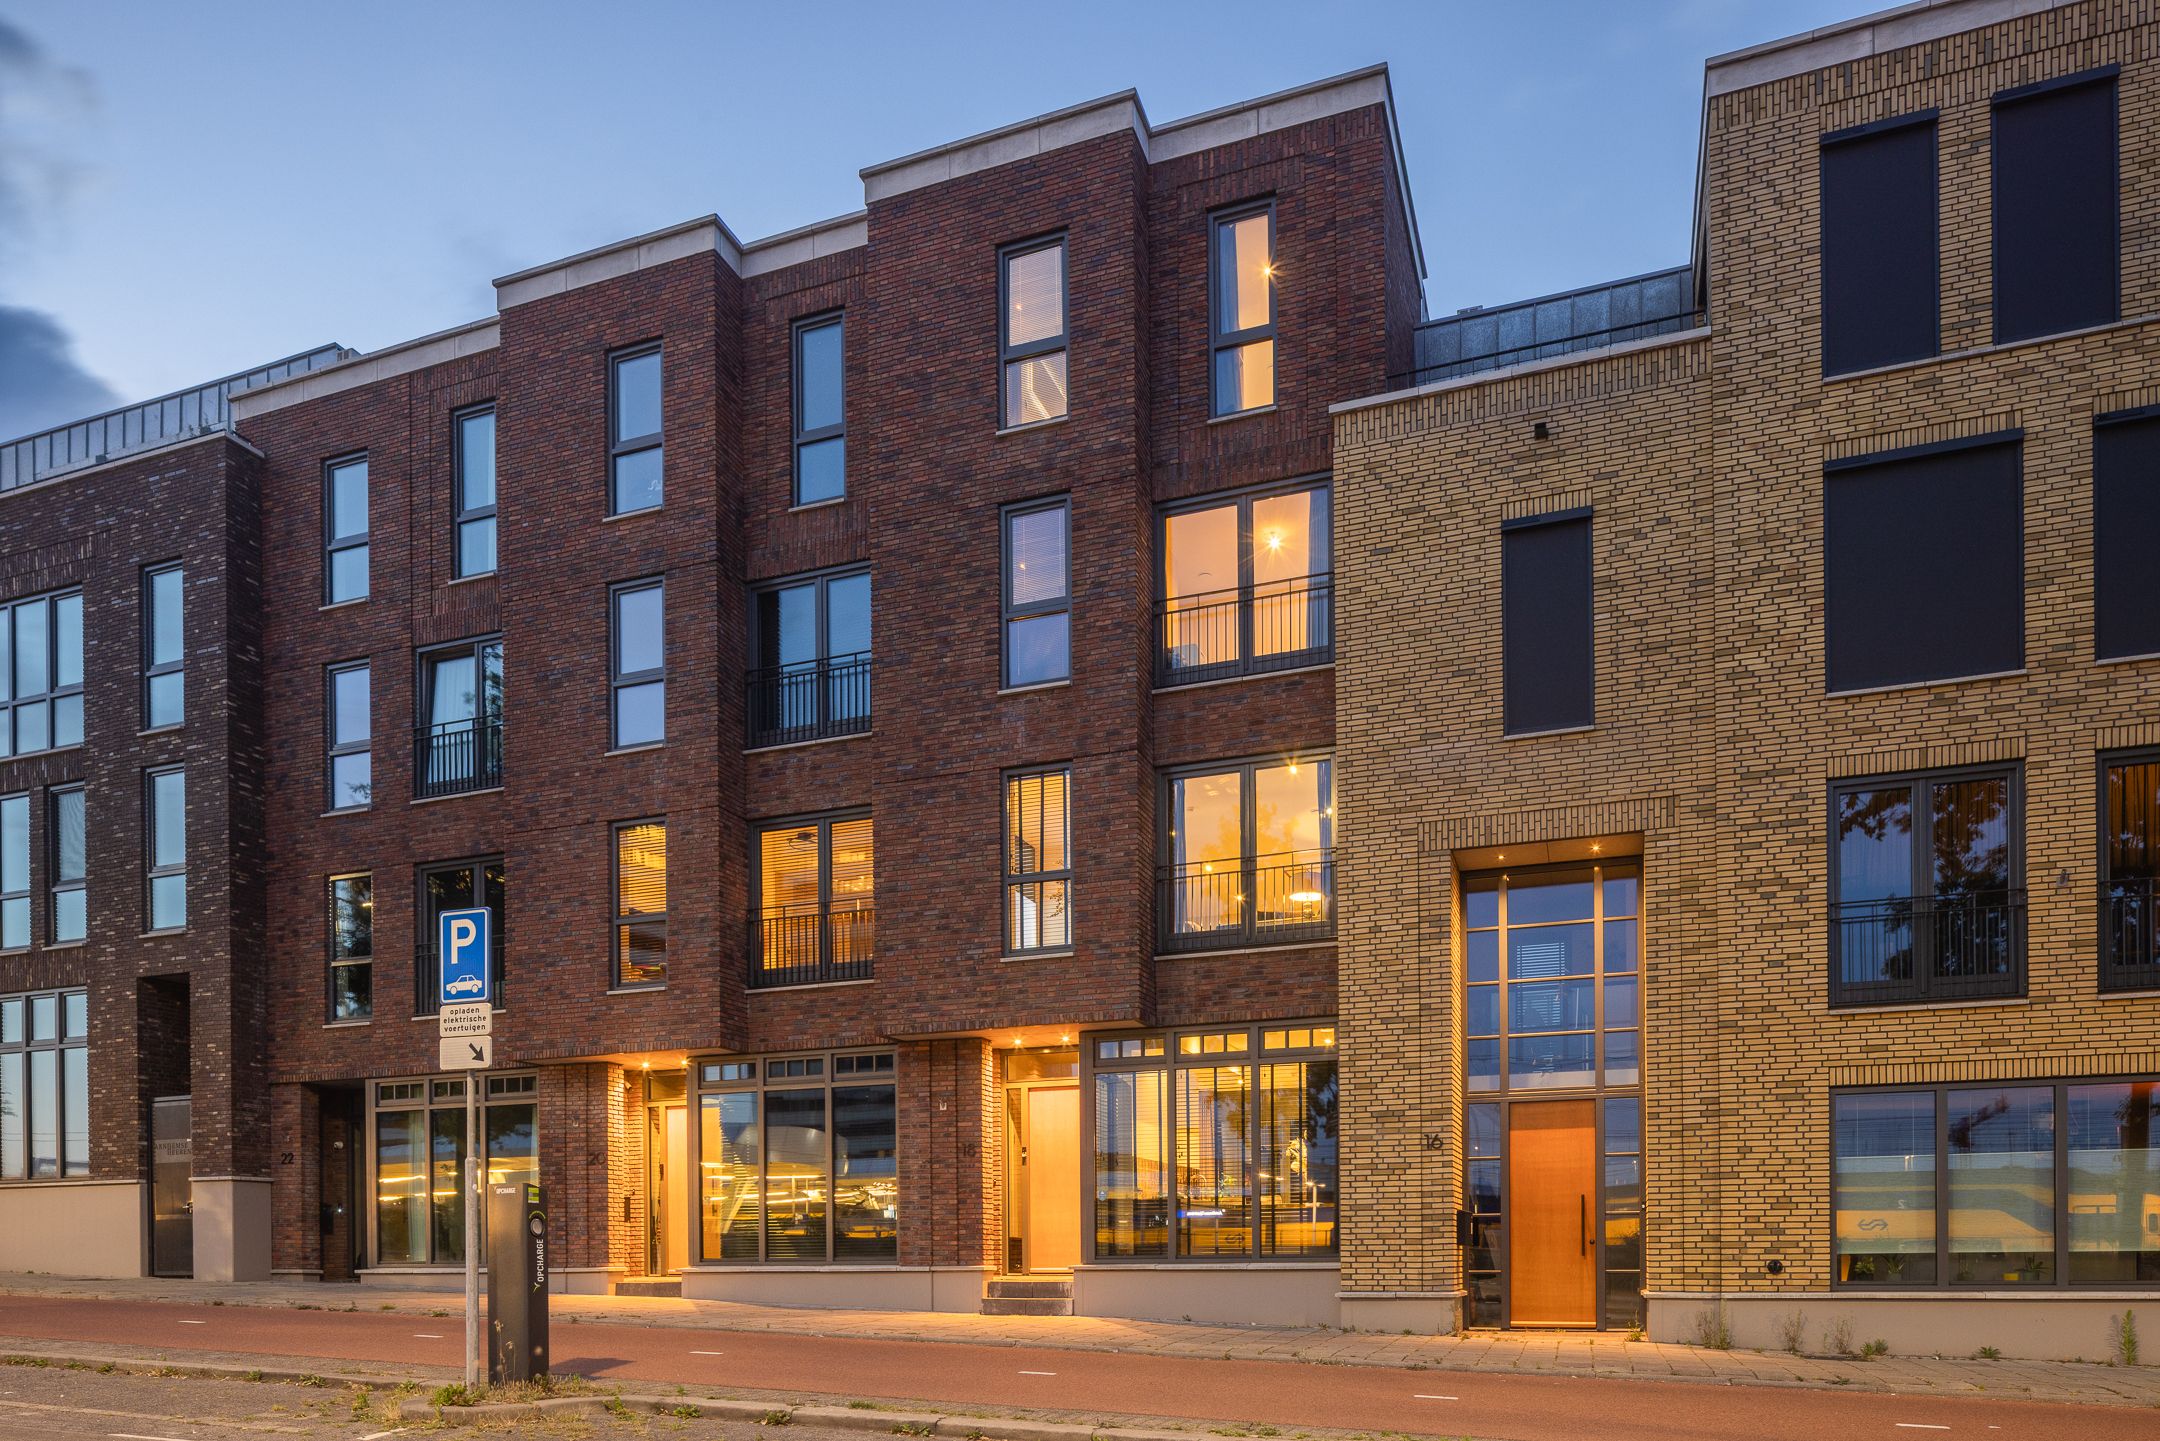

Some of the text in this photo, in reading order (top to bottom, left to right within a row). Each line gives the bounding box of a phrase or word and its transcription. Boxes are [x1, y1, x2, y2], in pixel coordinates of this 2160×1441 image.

[451, 919, 477, 964] P
[449, 1007, 480, 1017] opladen
[443, 1015, 487, 1025] elektrische
[444, 1024, 486, 1033] voertuigen
[1424, 1133, 1443, 1149] 16
[280, 1152, 294, 1165] 22
[589, 1152, 606, 1166] 20
[537, 1238, 545, 1283] OPCHARGE
